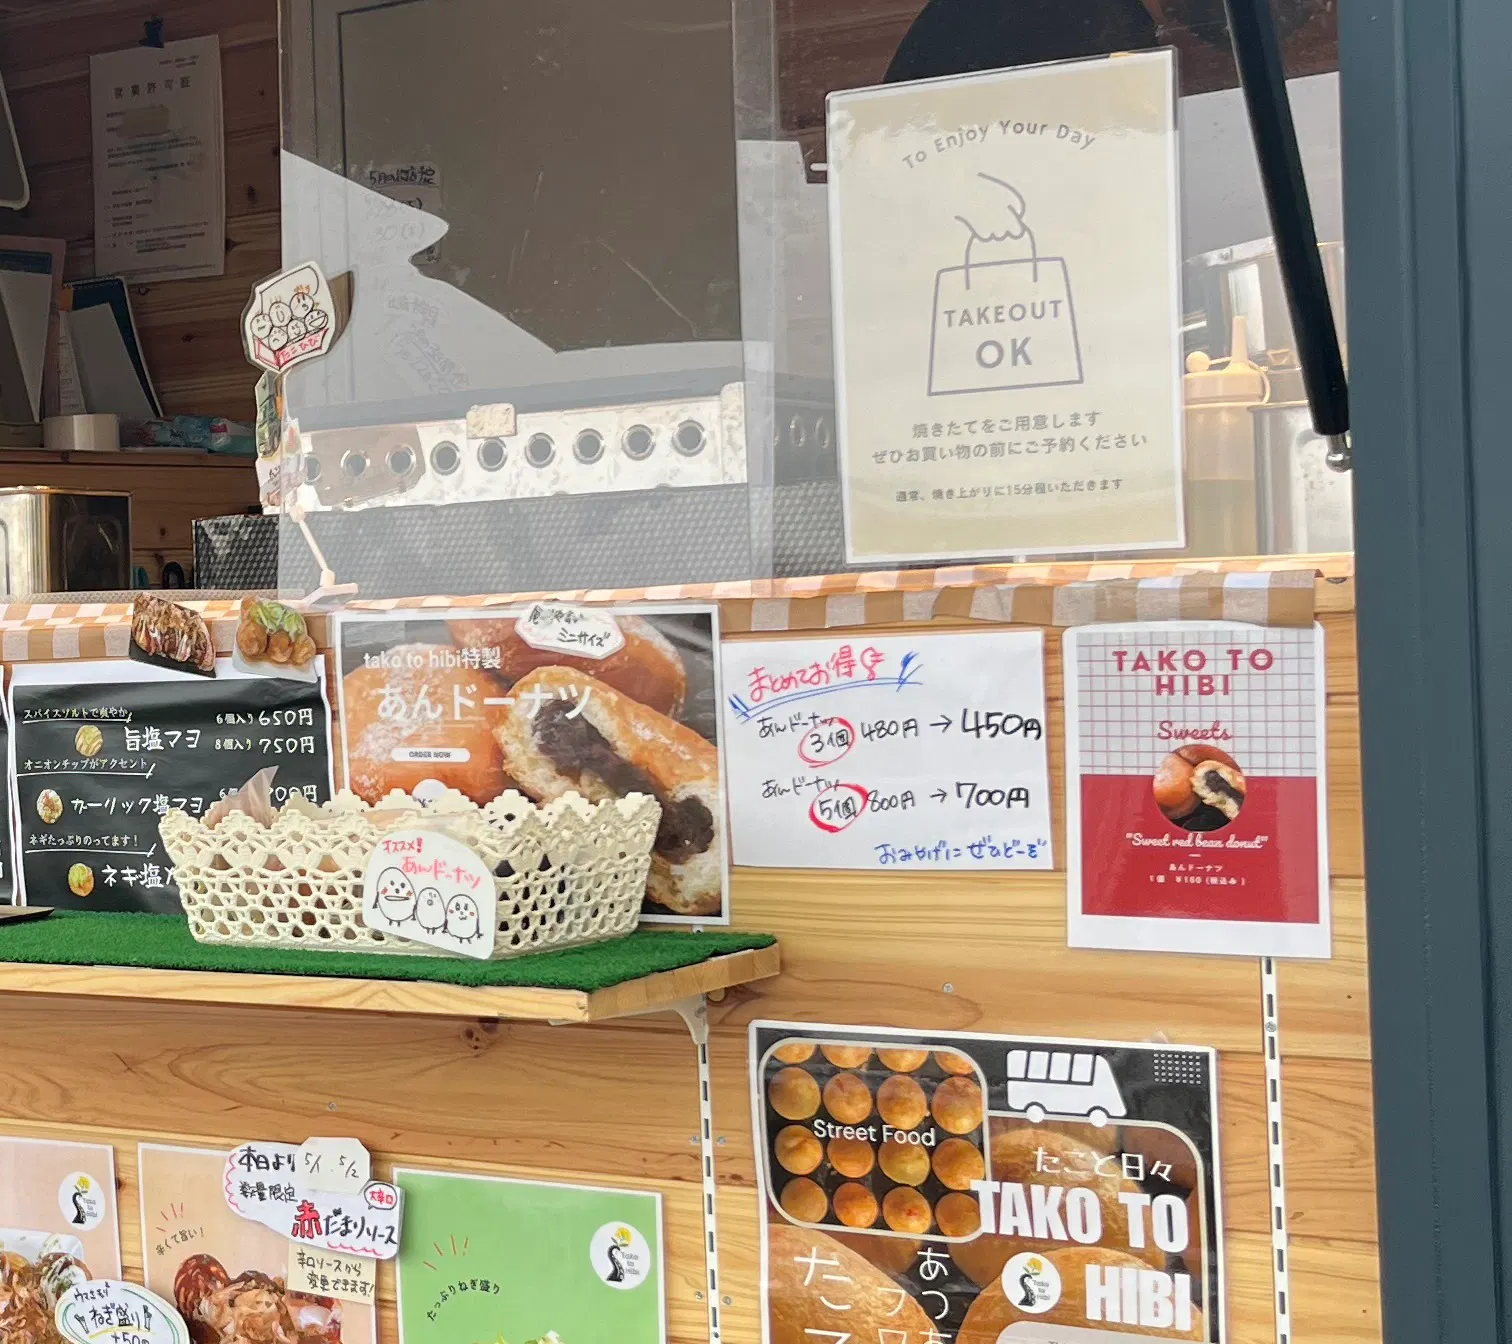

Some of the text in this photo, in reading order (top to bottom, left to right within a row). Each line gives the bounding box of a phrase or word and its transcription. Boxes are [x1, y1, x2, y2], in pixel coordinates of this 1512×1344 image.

[902, 120, 1096, 169] To Enjoy Your Day
[943, 300, 1062, 327] TAKEOUT
[975, 336, 1032, 369] OK
[912, 411, 1103, 439] 焼きたてをご用意します
[872, 433, 1147, 464] ぜひお買い物の前にご予約ください
[896, 478, 1123, 502] 通常、焼き上がりに15分程いただきます
[557, 628, 611, 647] ミニサイズ
[363, 652, 403, 669] tako
[407, 653, 425, 669] to
[1112, 648, 1273, 672] TAKO TO
[1155, 675, 1230, 696] HIBI
[373, 683, 592, 721] あんドーナツ
[216, 708, 314, 727] 6個入り 650円
[757, 707, 1042, 753] あんドーナツ 3個 480円 450円
[1157, 719, 1231, 741] Sweets
[124, 726, 201, 752] 旨塩マヨ
[215, 736, 315, 754] 8個入り 750円
[24, 759, 147, 771] オニオンチップがアクセント
[761, 778, 1029, 820] あんドーナツ 5個 800円 700円
[1172, 833, 1193, 847] red
[1195, 832, 1224, 847] bean
[402, 856, 481, 889] あんドーナツ
[1169, 863, 1223, 872] あんドーナツ
[813, 1119, 935, 1146] Street Food
[238, 1146, 296, 1172] 本日より
[1033, 1146, 1173, 1182] たこと日々
[239, 1180, 298, 1203] 数量限定
[291, 1200, 398, 1245] 赤だまりソース
[969, 1179, 1188, 1253] TAKO TO
[155, 1226, 204, 1256] 辛くて旨い!
[296, 1249, 361, 1277] 辛口ソースから
[307, 1272, 374, 1297] 変更できます!
[1085, 1264, 1191, 1331] HIBI
[426, 1279, 501, 1321] たっぷりねぎ盛り
[89, 1303, 141, 1331] ねぎ盛り
